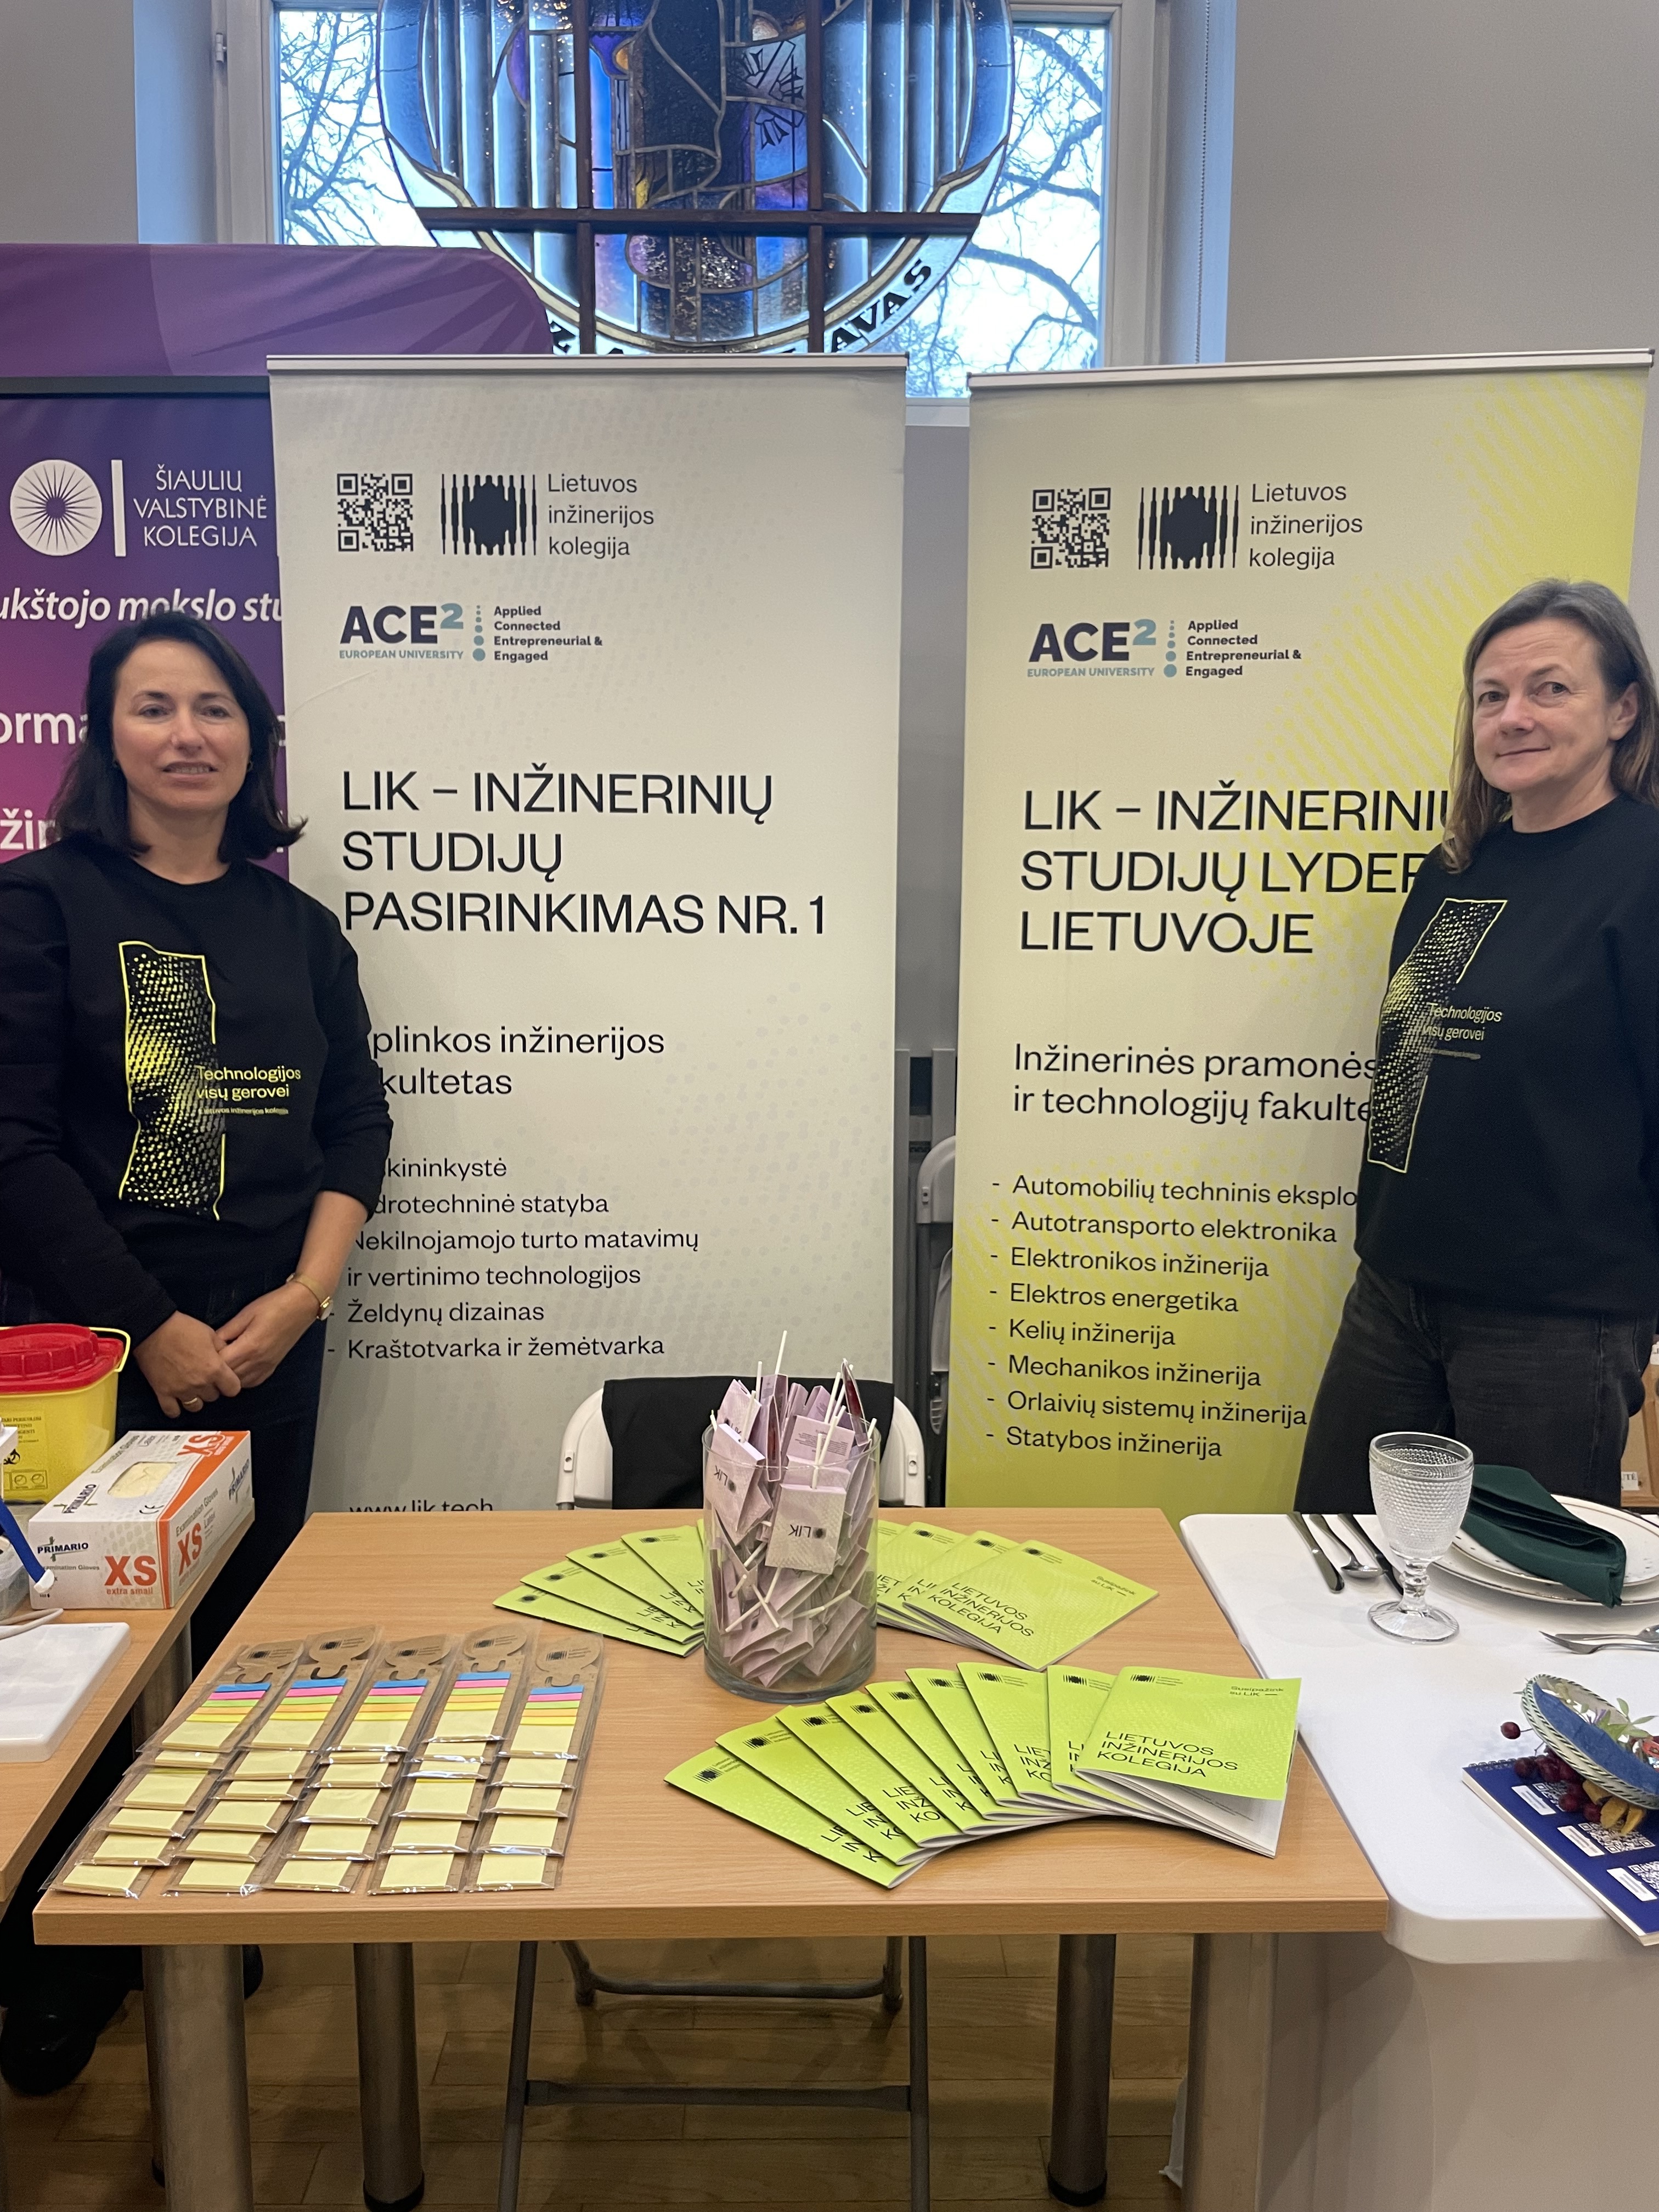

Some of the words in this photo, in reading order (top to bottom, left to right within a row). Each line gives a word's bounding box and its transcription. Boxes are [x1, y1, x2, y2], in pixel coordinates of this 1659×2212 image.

[156, 465, 241, 493] ŠIAULIŲ
[548, 473, 637, 493] Lietuvos
[1252, 483, 1346, 503] Lietuvos
[133, 495, 267, 520] VALSTYBINĖ
[549, 505, 654, 528] inžinerijos
[144, 526, 257, 547] KOLEGIJA
[1251, 514, 1363, 537] inžinerijos
[549, 536, 630, 560] kolegija
[1249, 546, 1335, 570] kolegija
[494, 605, 541, 618] Applied
[494, 620, 561, 631] Connected
[1188, 619, 1238, 633] Applied
[494, 635, 591, 648] Entrepreneurial
[594, 636, 602, 646] &
[1187, 634, 1258, 646] Connected
[339, 650, 396, 659] EUROPEAN
[399, 650, 464, 659] UNIVERSITY
[494, 650, 548, 663] Engaged
[1186, 649, 1290, 663] Entrepreneurial
[1292, 649, 1302, 659] &
[1027, 667, 1086, 678] EUROPEAN
[1088, 667, 1155, 677] UNIVERSITY
[1186, 665, 1243, 679] Engaged
[343, 771, 419, 811] LIK
[474, 763, 771, 825] INŽINERINIŲ
[1025, 790, 1102, 830] LIK
[342, 831, 561, 883] STUDIJŲ
[1020, 851, 1246, 902] STUDIJŲ
[345, 891, 704, 934] PASIRINKIMAS
[719, 895, 797, 934] NR.
[810, 895, 823, 934] 1
[1021, 911, 1314, 953] LIETUVOJE
[1427, 1002, 1503, 1024] Technologijos
[373, 1026, 490, 1059] plinkos
[500, 1025, 665, 1060] inžinerijos
[1444, 1026, 1485, 1041] gerovei
[1015, 1043, 1194, 1076] Inžinerinės
[194, 1065, 301, 1083] Technologijos
[380, 1067, 512, 1095] kultetas
[196, 1085, 228, 1101] visų
[232, 1084, 289, 1102] gerovei
[1014, 1086, 1034, 1113] ir
[1043, 1087, 1248, 1125] technologijų
[1258, 1091, 1370, 1122] fakulte
[387, 1158, 507, 1181] kininkystė
[1012, 1175, 1154, 1203] Automobilių
[1161, 1180, 1271, 1204] techninis
[1277, 1185, 1357, 1210] eksplo
[374, 1194, 515, 1215] drotechninė
[521, 1194, 609, 1216] statyba
[1011, 1211, 1195, 1239] Autotransporto
[1201, 1219, 1337, 1243] elektronika
[521, 1231, 578, 1249] turto
[585, 1228, 698, 1251] matavimų
[1011, 1247, 1156, 1272] Elektronikos
[1163, 1254, 1268, 1280] inžinerija
[347, 1267, 362, 1286] ir
[369, 1267, 479, 1286] vertinimo
[486, 1265, 641, 1288] technologijos
[1010, 1283, 1105, 1307] Elektros
[1112, 1291, 1238, 1314] energetika
[347, 1299, 442, 1327] Želdynų
[449, 1302, 544, 1321] dizainas
[1009, 1319, 1065, 1346] Kelių
[1071, 1323, 1175, 1349] inžinerija
[348, 1338, 500, 1359] Kraštotvarka
[507, 1339, 522, 1357] ir
[528, 1335, 664, 1357] žemėtvarka
[1008, 1356, 1149, 1381] Mechanikos
[1155, 1361, 1261, 1390] inžinerija
[1007, 1391, 1096, 1418] Orlaivių
[1102, 1398, 1194, 1423] sistemų
[1201, 1401, 1307, 1429] inžinerija
[177, 1434, 223, 1457] XS
[1006, 1426, 1111, 1452] Statybos
[1118, 1431, 1222, 1460] inžinerija
[714, 1465, 728, 1486] LIK
[203, 1487, 219, 1508] Gloves
[788, 1524, 811, 1538] LIK
[37, 1542, 89, 1554] PRIMARIO
[177, 1522, 202, 1577] XS
[104, 1555, 157, 1586] XS
[940, 1588, 1034, 1637] INŽINERIJOS
[952, 1582, 1028, 1621] LIETUVOS
[927, 1594, 1002, 1634] KOLEGIJA
[1101, 1740, 1239, 1771] INŽINERIJOS
[1105, 1731, 1215, 1756] LIETUVOS
[1097, 1750, 1207, 1778] KOLEGIJA
